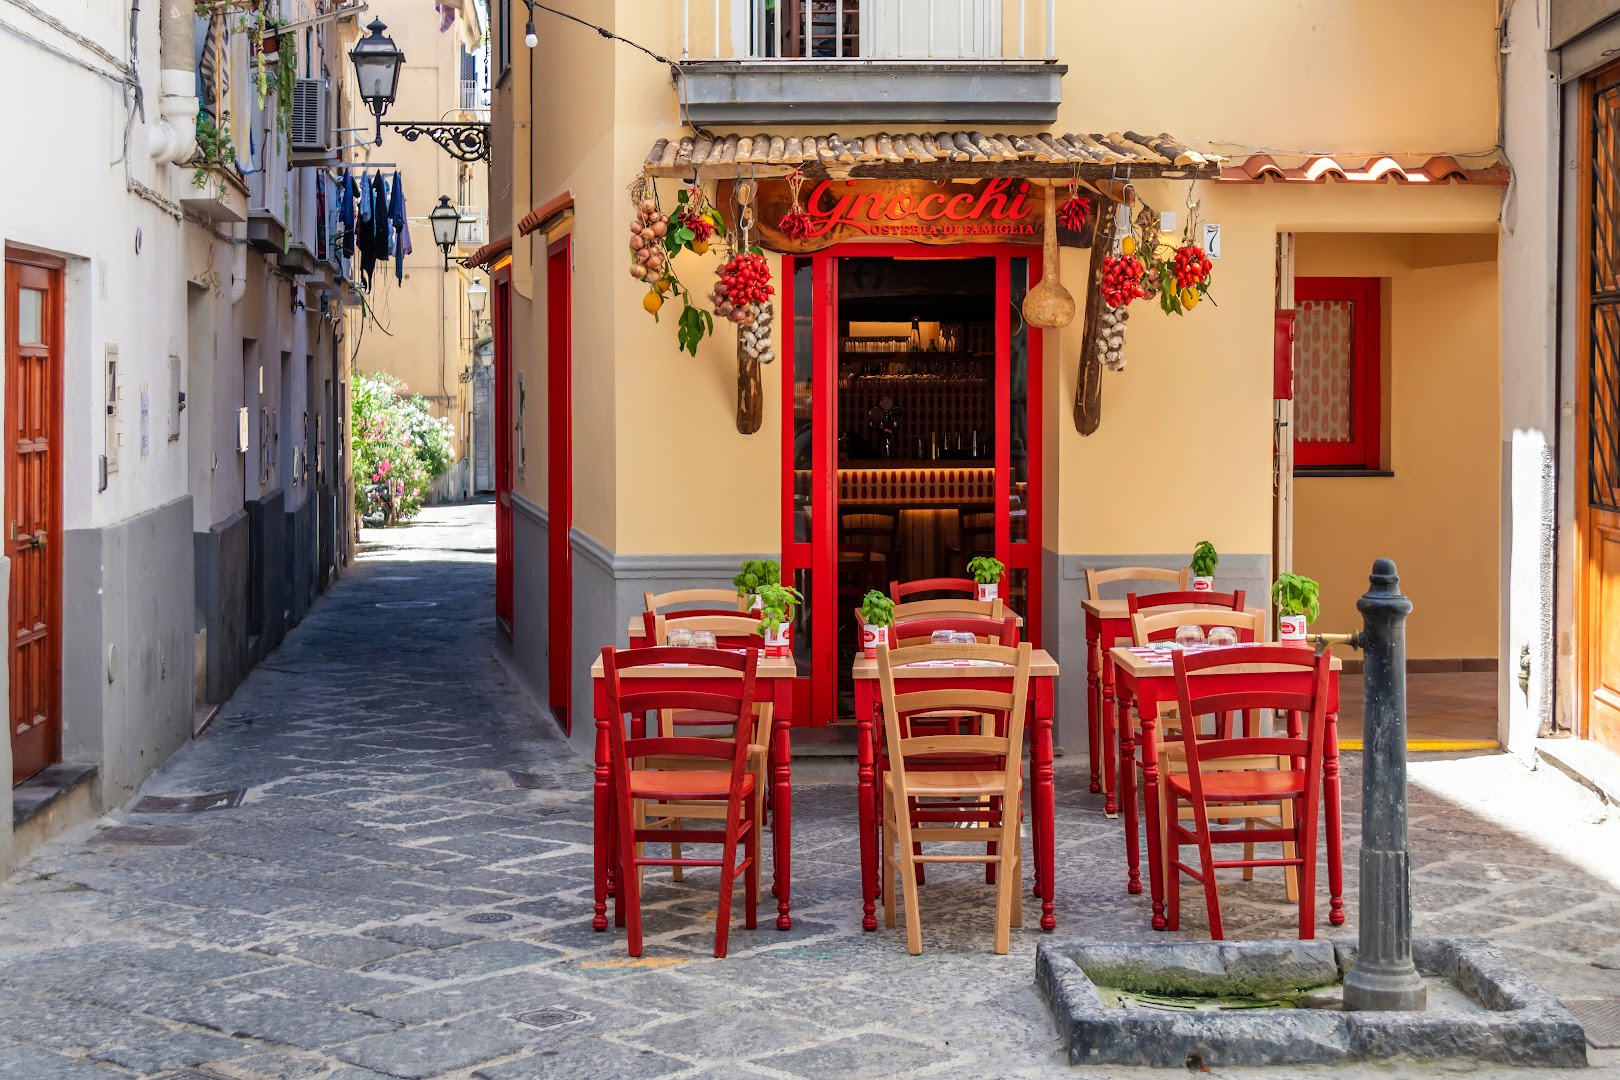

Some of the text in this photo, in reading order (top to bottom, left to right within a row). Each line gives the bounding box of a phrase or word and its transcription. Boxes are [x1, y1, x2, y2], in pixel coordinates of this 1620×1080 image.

[808, 177, 1033, 237] Gnocchi
[871, 225, 1034, 236] OSTERIA DI FAMIGLIA
[1207, 229, 1219, 252] 7
